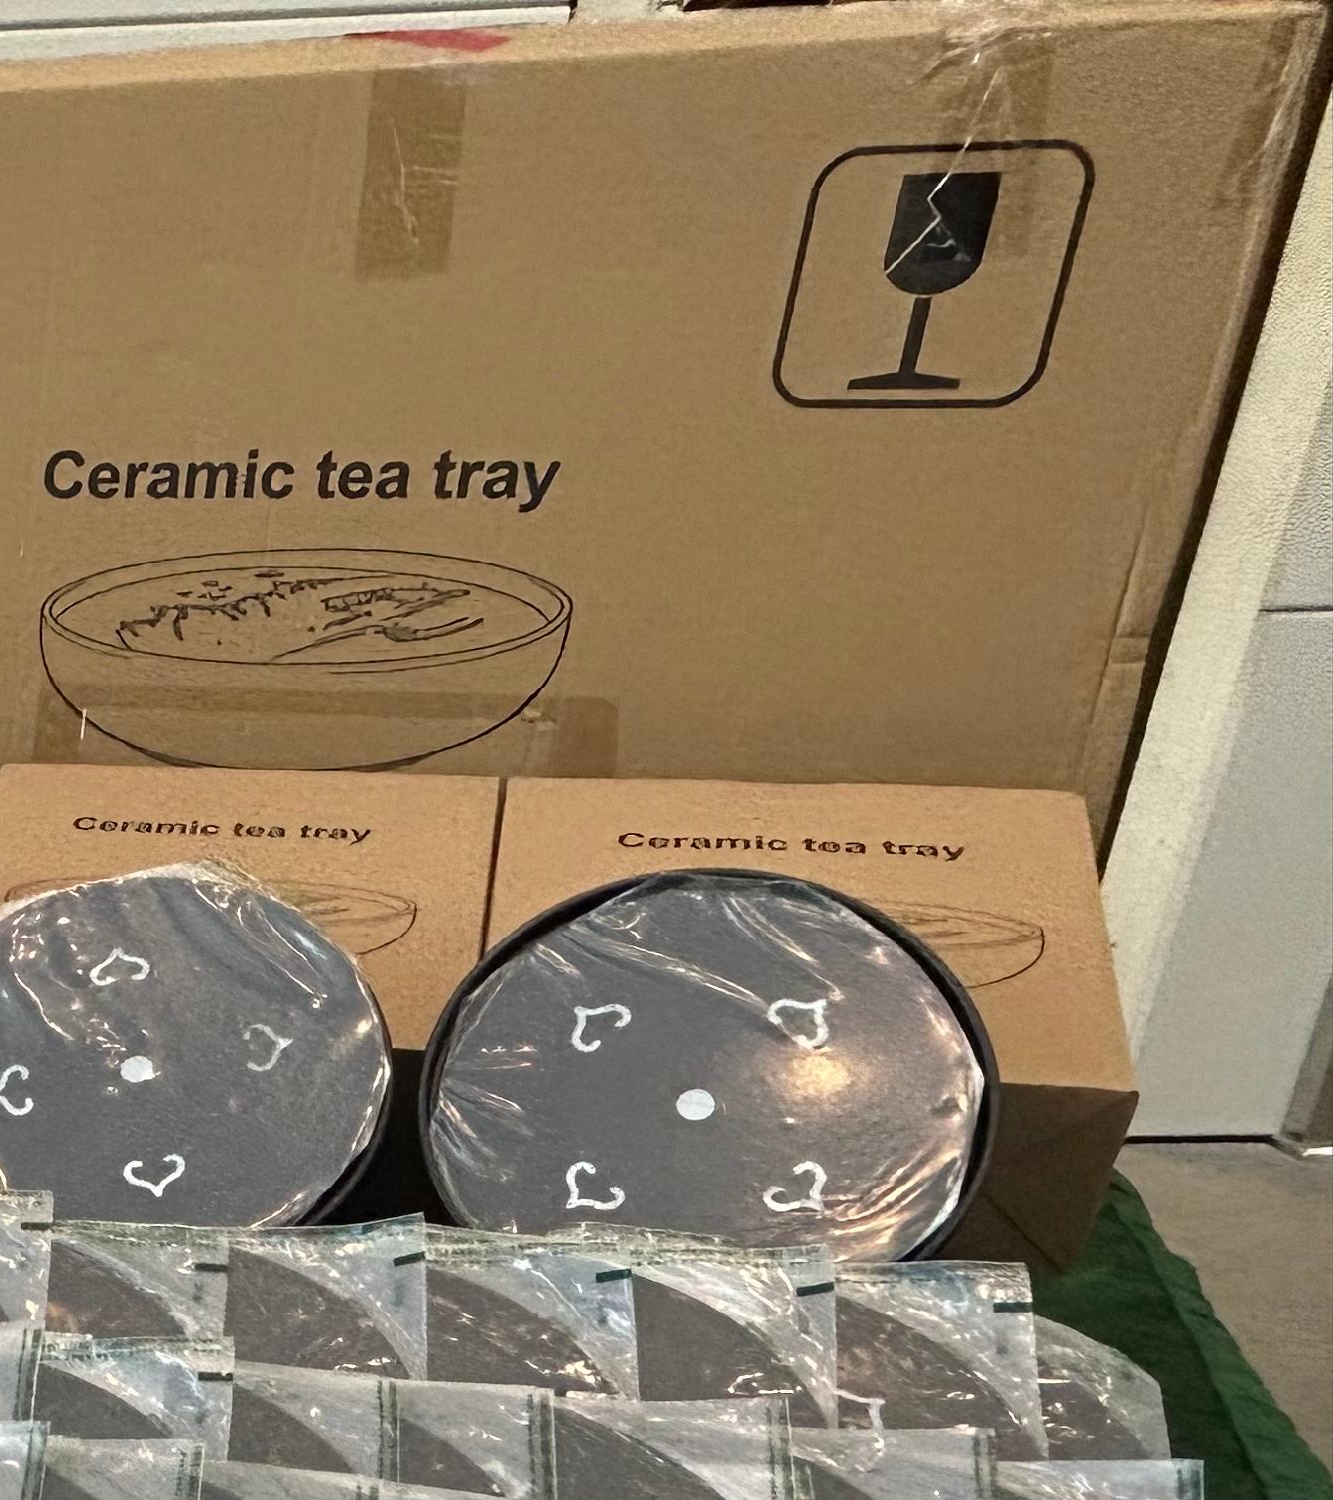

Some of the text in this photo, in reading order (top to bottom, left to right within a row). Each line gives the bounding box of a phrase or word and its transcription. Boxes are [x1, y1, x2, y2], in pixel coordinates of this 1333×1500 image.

[43, 448, 561, 513] Ceramic tea tray
[72, 816, 372, 846] Ceramic tea tray
[617, 832, 966, 862] Ceramic tea tray
